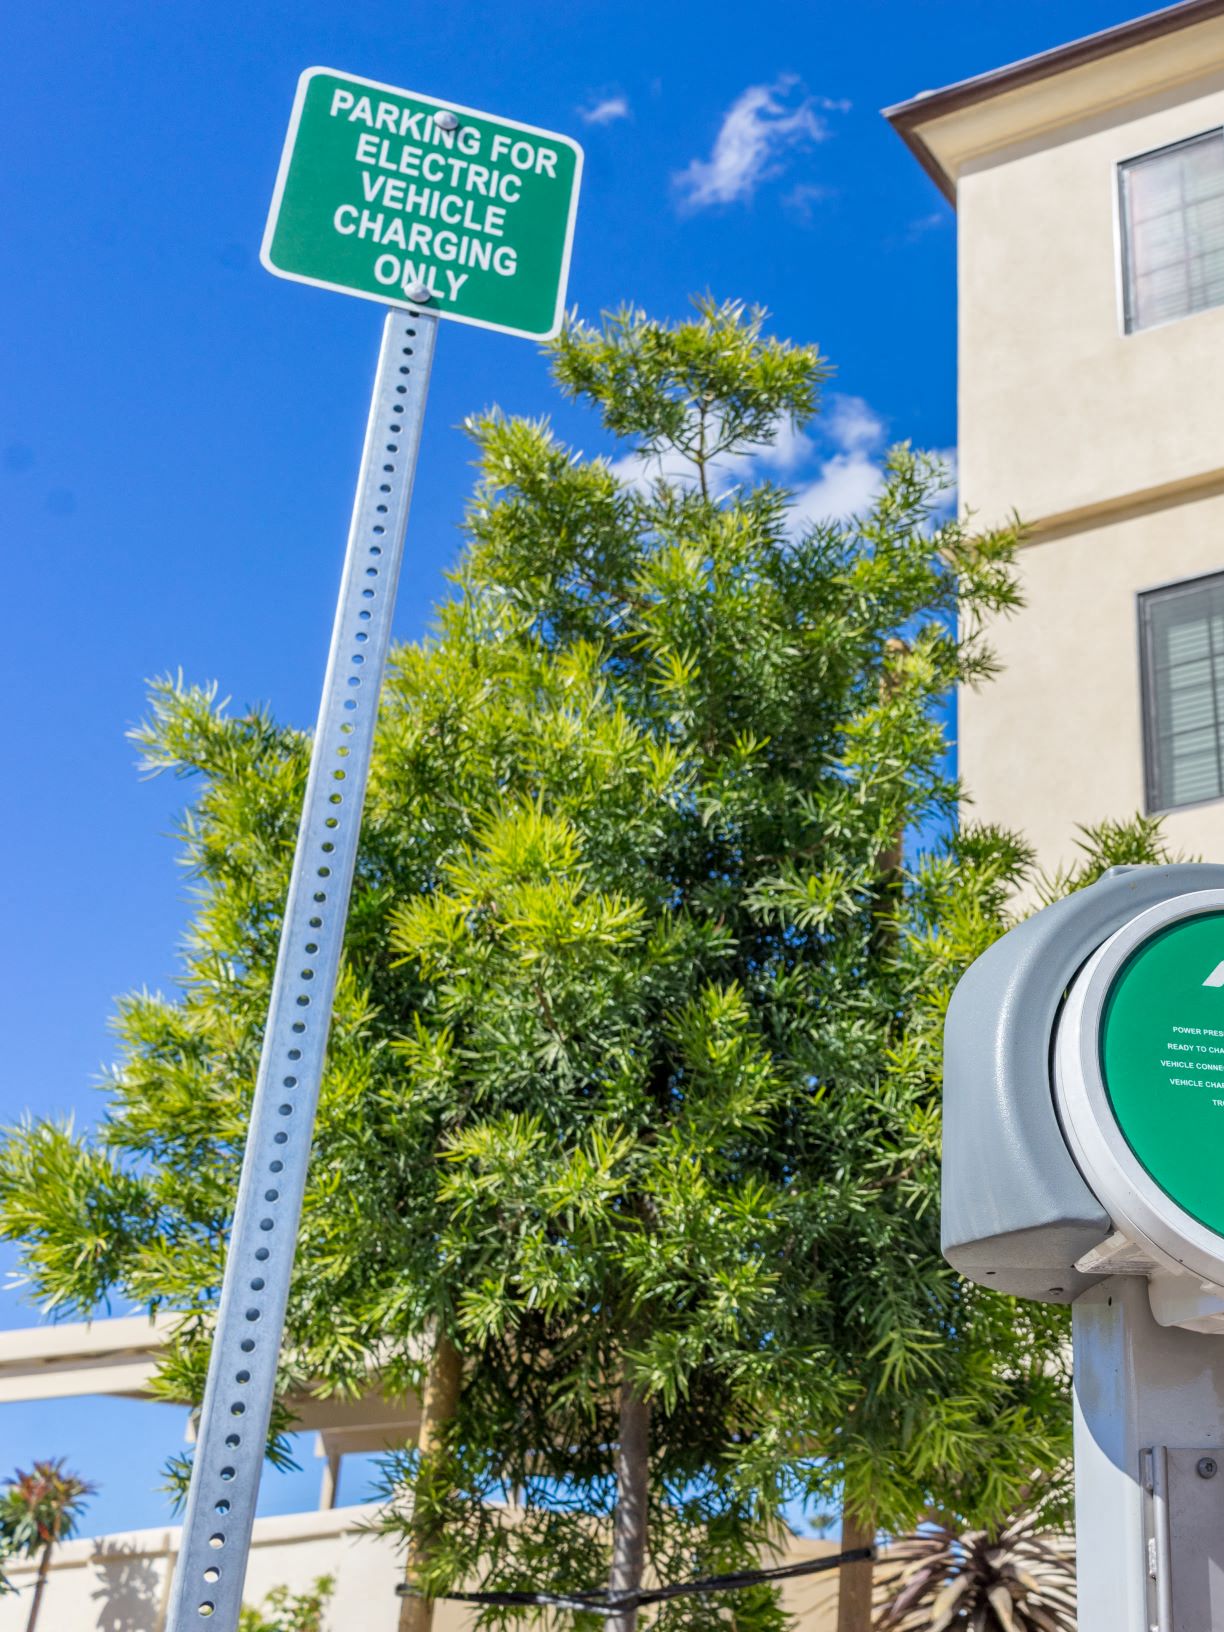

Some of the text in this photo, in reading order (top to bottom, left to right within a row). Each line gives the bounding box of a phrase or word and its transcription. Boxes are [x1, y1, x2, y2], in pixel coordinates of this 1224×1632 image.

[329, 88, 558, 179] PARKING FOR
[355, 133, 522, 203] ELECTRIC
[361, 171, 507, 237] VEHICLE
[333, 204, 518, 276] CHARGING
[374, 253, 469, 302] ONLY
[1167, 1043, 1194, 1051] READY
[1172, 1026, 1202, 1035] POWER
[1160, 1060, 1194, 1069] VEHICLE
[1169, 1078, 1203, 1087] VEHICLE
